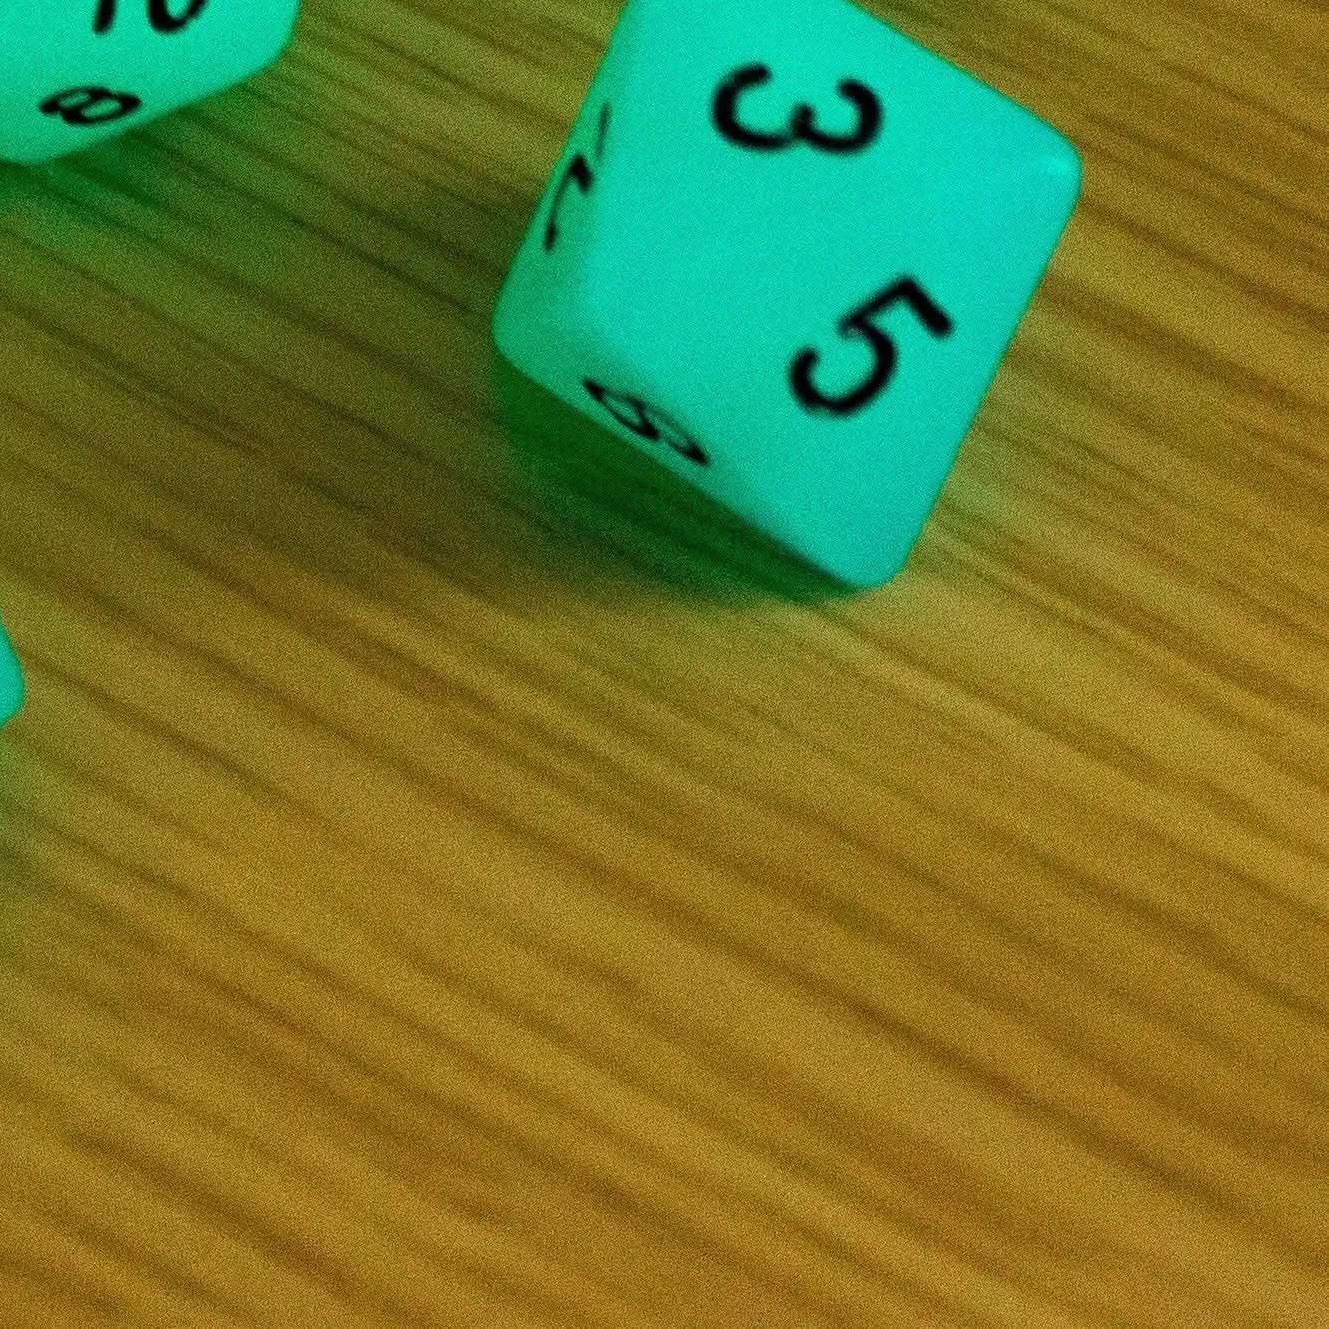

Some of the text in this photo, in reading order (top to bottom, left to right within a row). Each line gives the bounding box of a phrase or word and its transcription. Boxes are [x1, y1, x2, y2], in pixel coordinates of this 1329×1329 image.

[38, 86, 142, 125] 8
[711, 63, 883, 156] 3
[788, 276, 953, 418] 5
